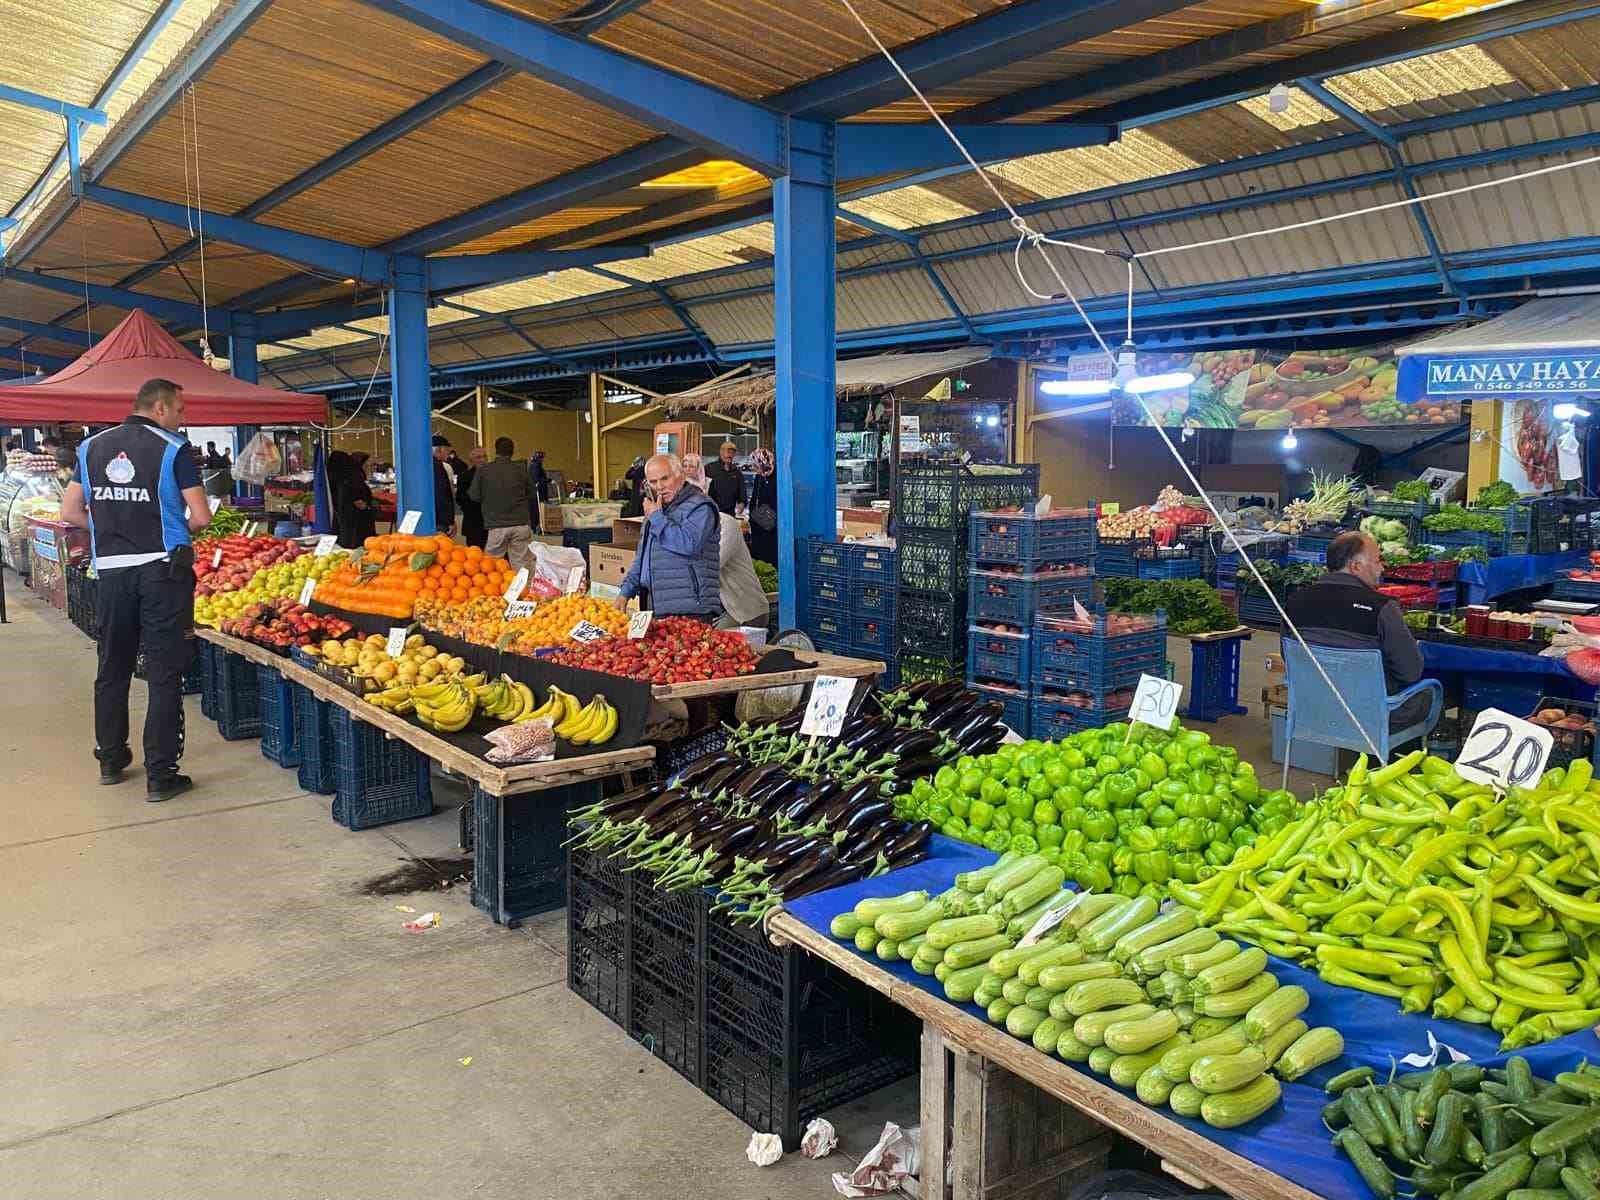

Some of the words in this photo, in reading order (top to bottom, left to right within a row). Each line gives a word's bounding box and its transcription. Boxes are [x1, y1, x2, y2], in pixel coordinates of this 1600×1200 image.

[1432, 362, 1525, 383] MANAV
[1474, 383, 1483, 391] 0
[1487, 382, 1512, 391] 546
[1517, 382, 1543, 390] 549
[1546, 381, 1564, 389] 65
[1569, 380, 1588, 389] 56
[92, 486, 151, 502] ZABITA
[1138, 679, 1175, 718] 30
[1459, 722, 1543, 784] 20
